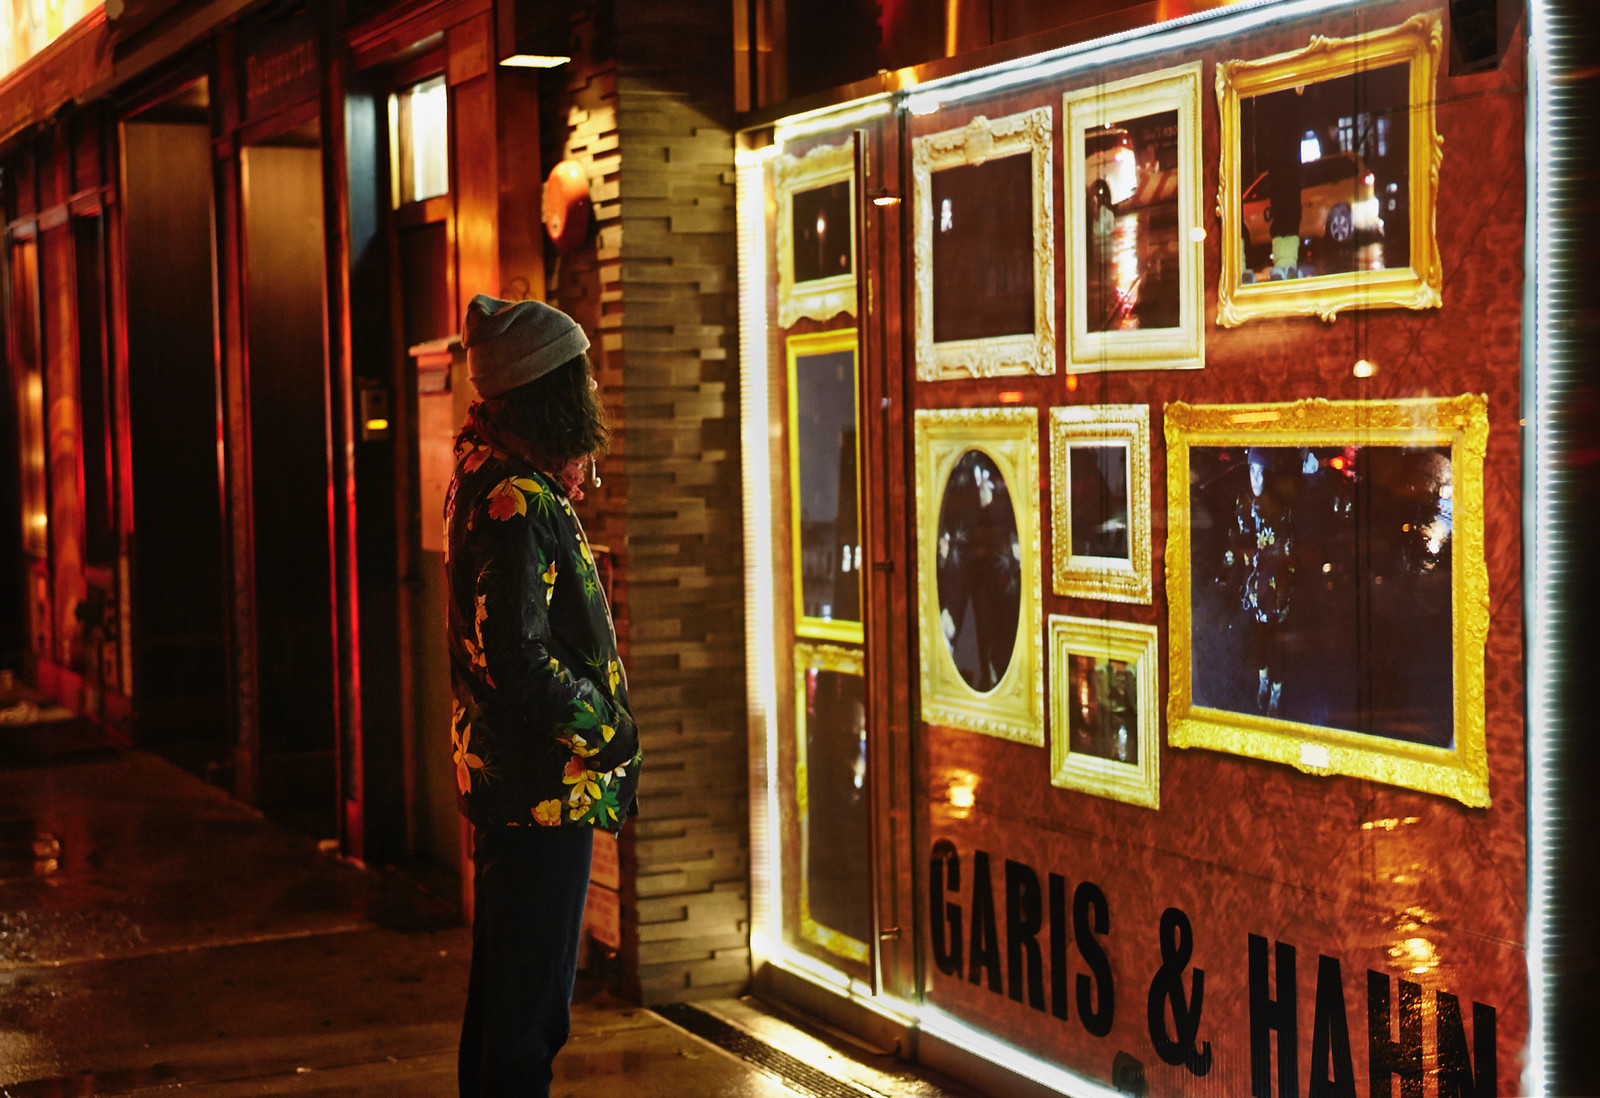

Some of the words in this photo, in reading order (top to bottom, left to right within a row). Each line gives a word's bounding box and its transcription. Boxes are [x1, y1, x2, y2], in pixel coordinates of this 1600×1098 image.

[930, 838, 1114, 1038] GARIS
[1148, 907, 1211, 1077] &
[1248, 933, 1498, 1098] HAHN
